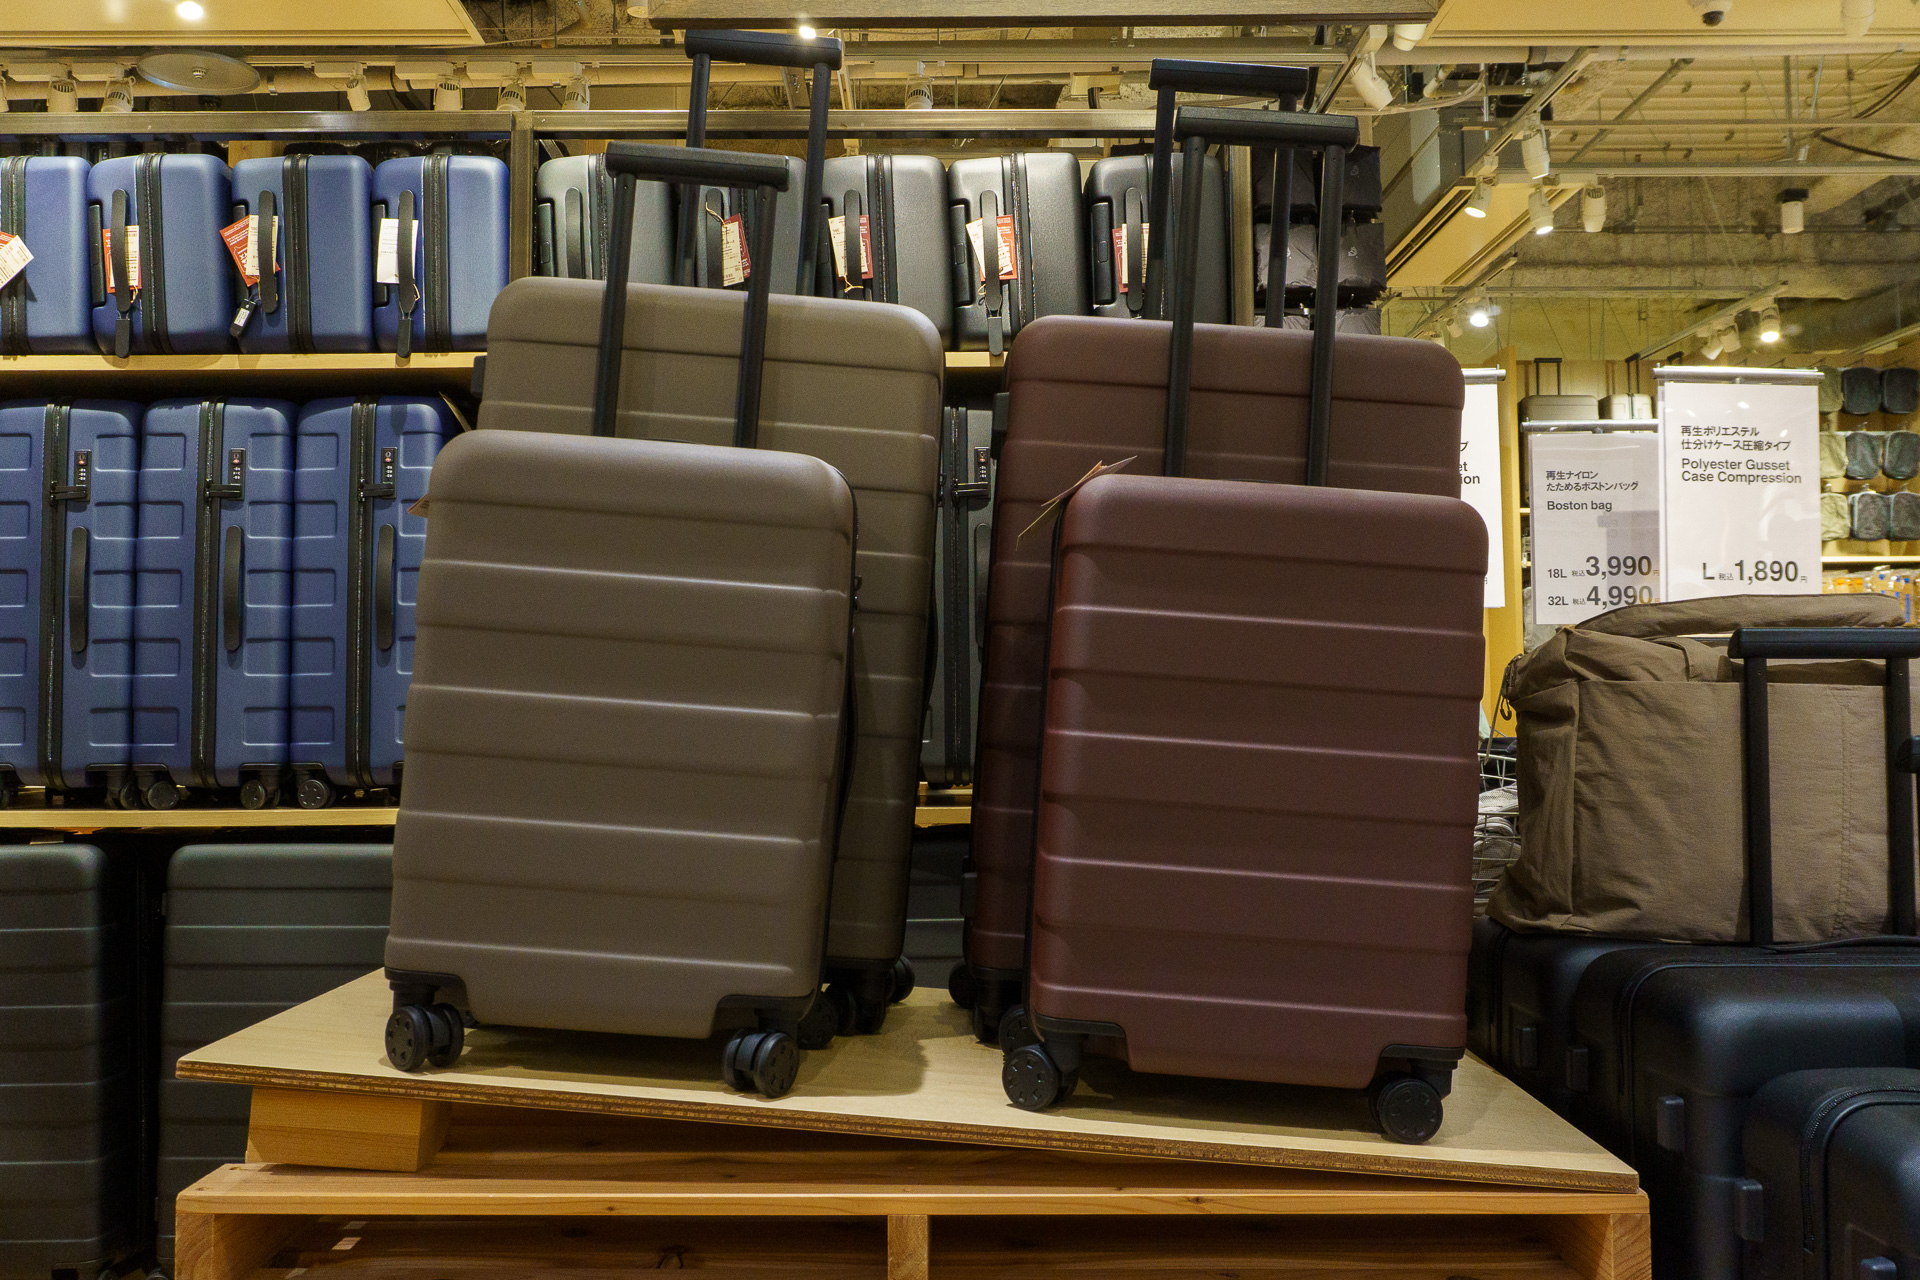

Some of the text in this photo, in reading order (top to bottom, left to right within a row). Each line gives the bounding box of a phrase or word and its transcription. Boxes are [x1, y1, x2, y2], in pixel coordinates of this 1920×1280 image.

[1681, 426, 1760, 436] 再生ポリエステル
[1681, 439, 1791, 451] 仕分けケース圧縮タイプ
[1682, 458, 1790, 472] Polyester Gusset
[1460, 473, 1480, 484] ion
[1546, 470, 1598, 480] 再生ナイロン
[1682, 470, 1802, 485] Case Compression
[1546, 481, 1639, 492] たためるボストンバッグ
[1547, 501, 1612, 512] Boston bag
[1548, 568, 1568, 578] 18L
[1586, 556, 1652, 580] 3,990
[1702, 562, 1715, 580] L
[1735, 560, 1798, 585] 1,890
[1548, 596, 1569, 606] 32L
[1586, 586, 1653, 610] 4,990
